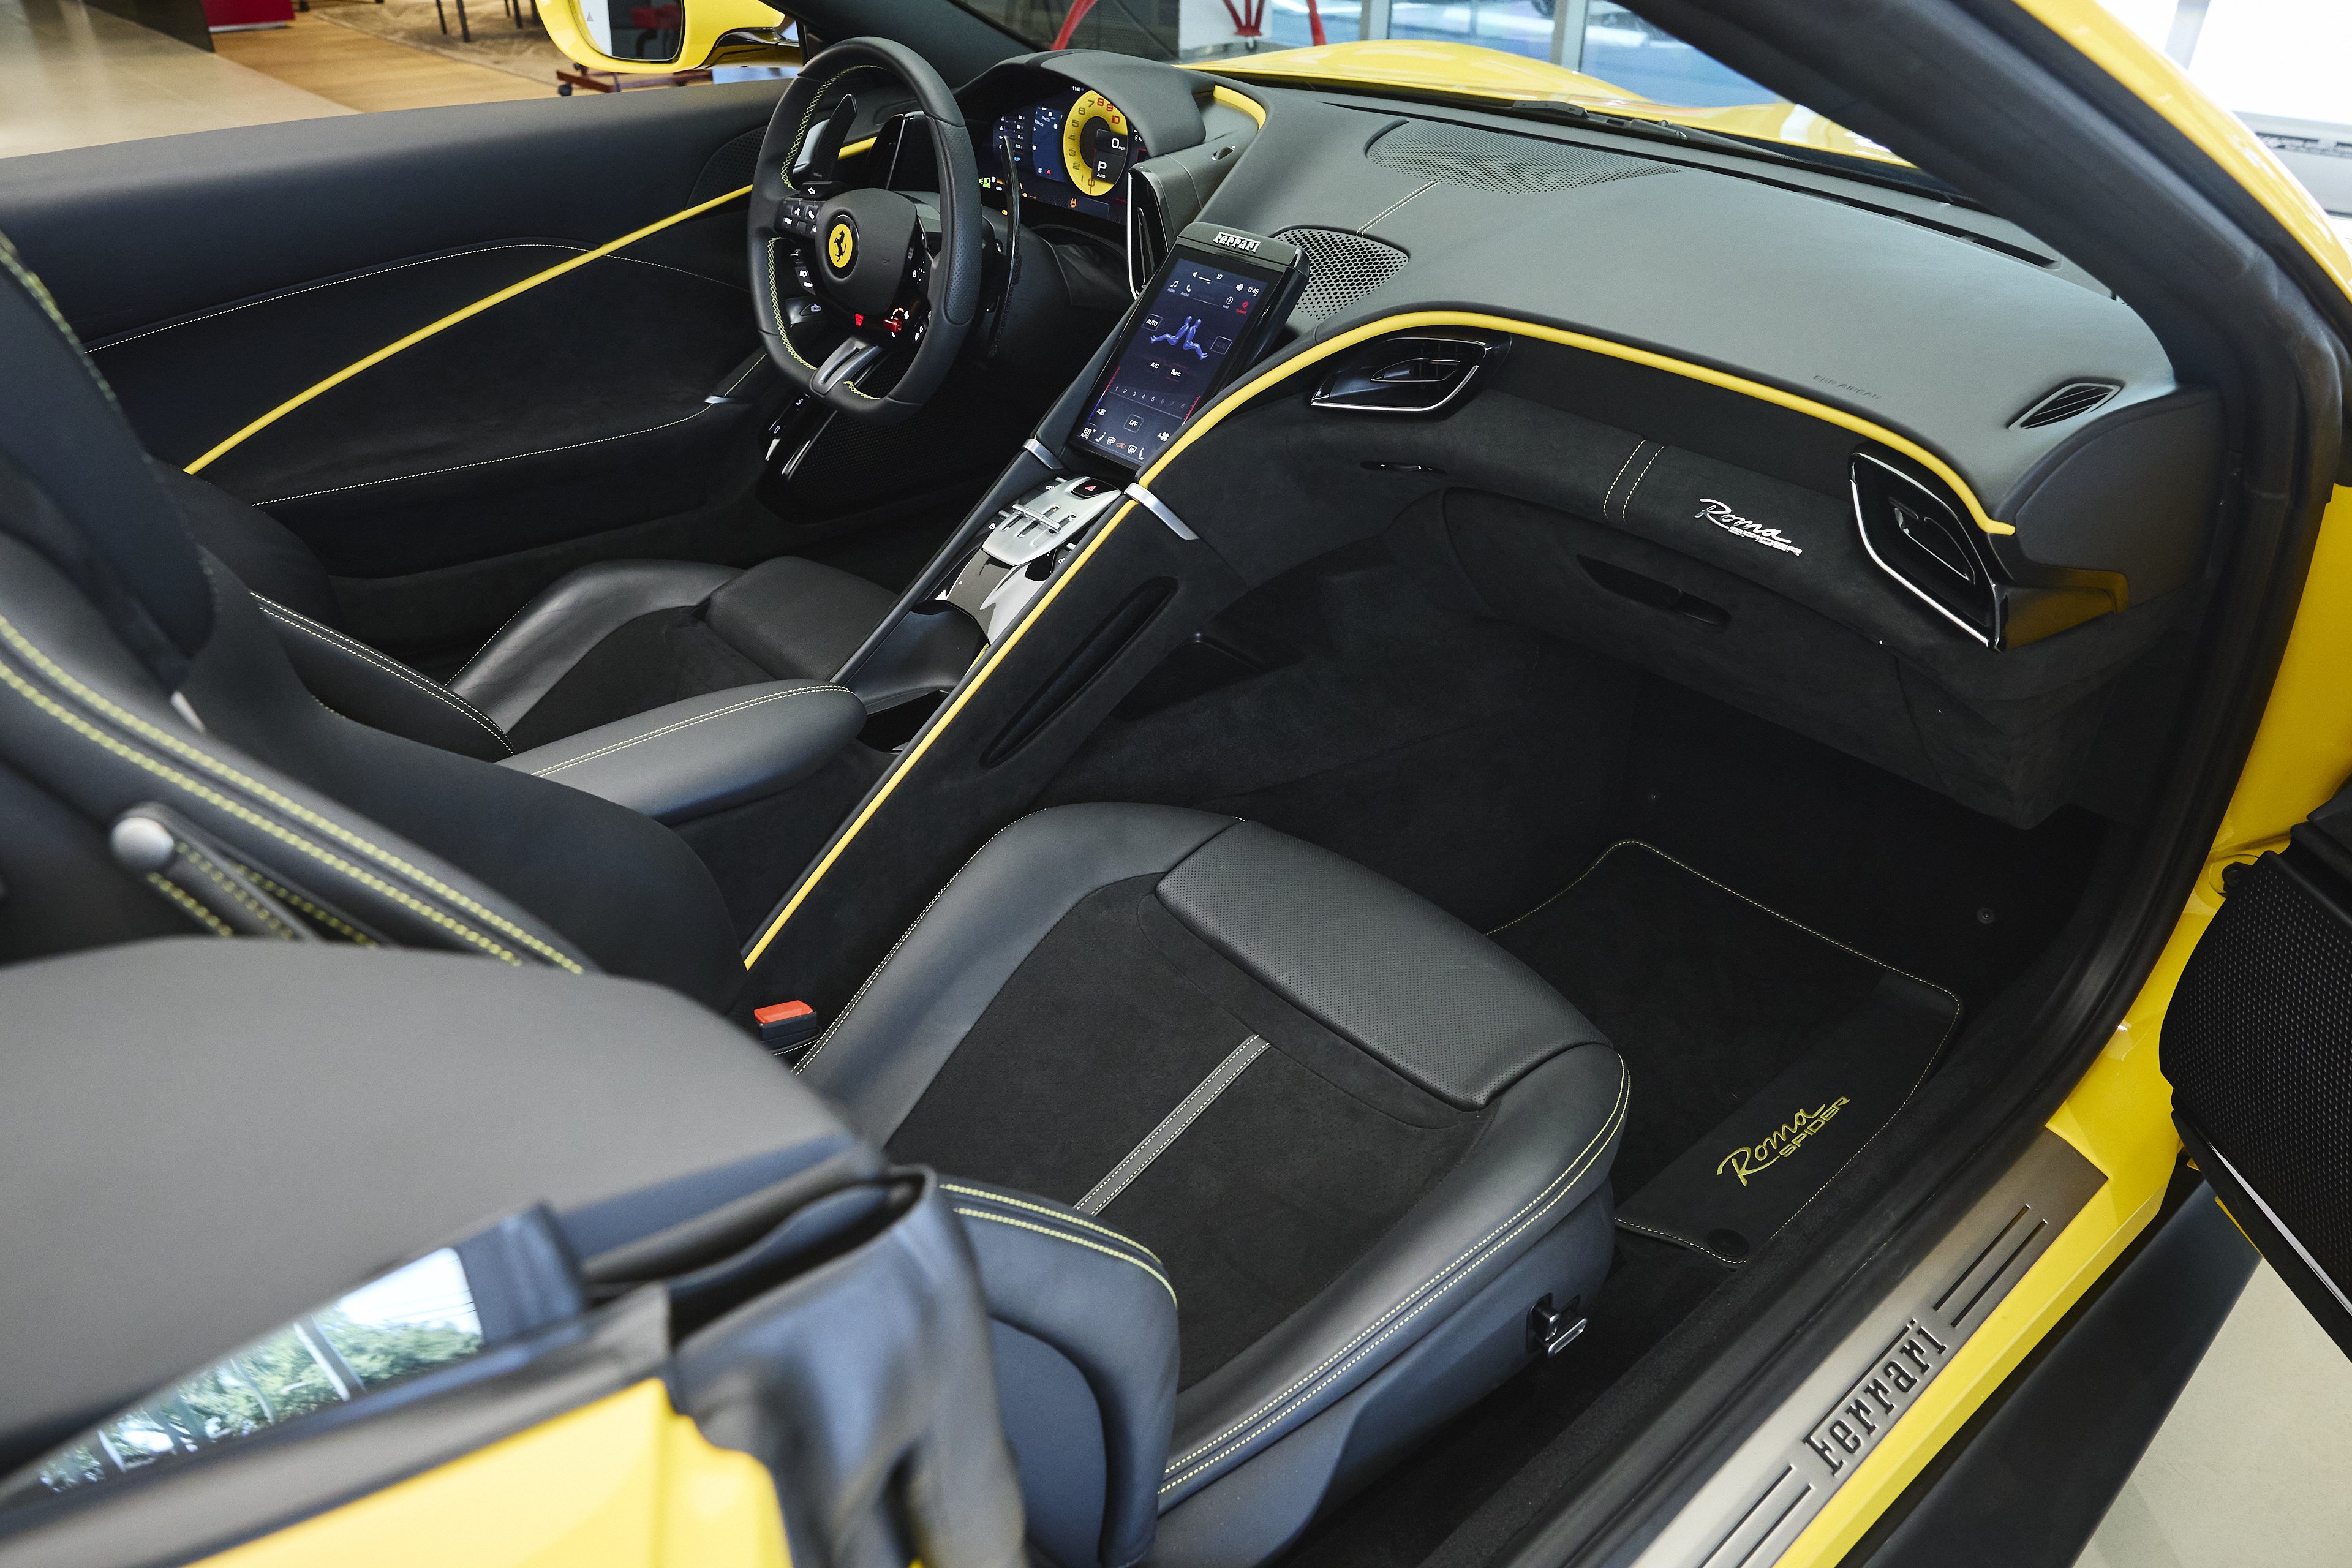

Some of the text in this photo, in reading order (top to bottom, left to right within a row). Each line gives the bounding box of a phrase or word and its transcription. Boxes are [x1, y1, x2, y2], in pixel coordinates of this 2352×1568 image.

[1097, 97, 1104, 106] 8
[1111, 138, 1119, 149] 0
[1073, 162, 1080, 170] 2
[1098, 160, 1107, 172] P
[1213, 231, 1261, 252] Ferrari
[1247, 286, 1260, 295] 11:45
[1084, 427, 1092, 435] 69
[1694, 498, 1792, 544] Roma
[1728, 526, 1803, 556] SPIDER
[1779, 1096, 1850, 1158] SPIDER
[1716, 1104, 1826, 1186] Roma
[1802, 1318, 1948, 1477] Ferrari
